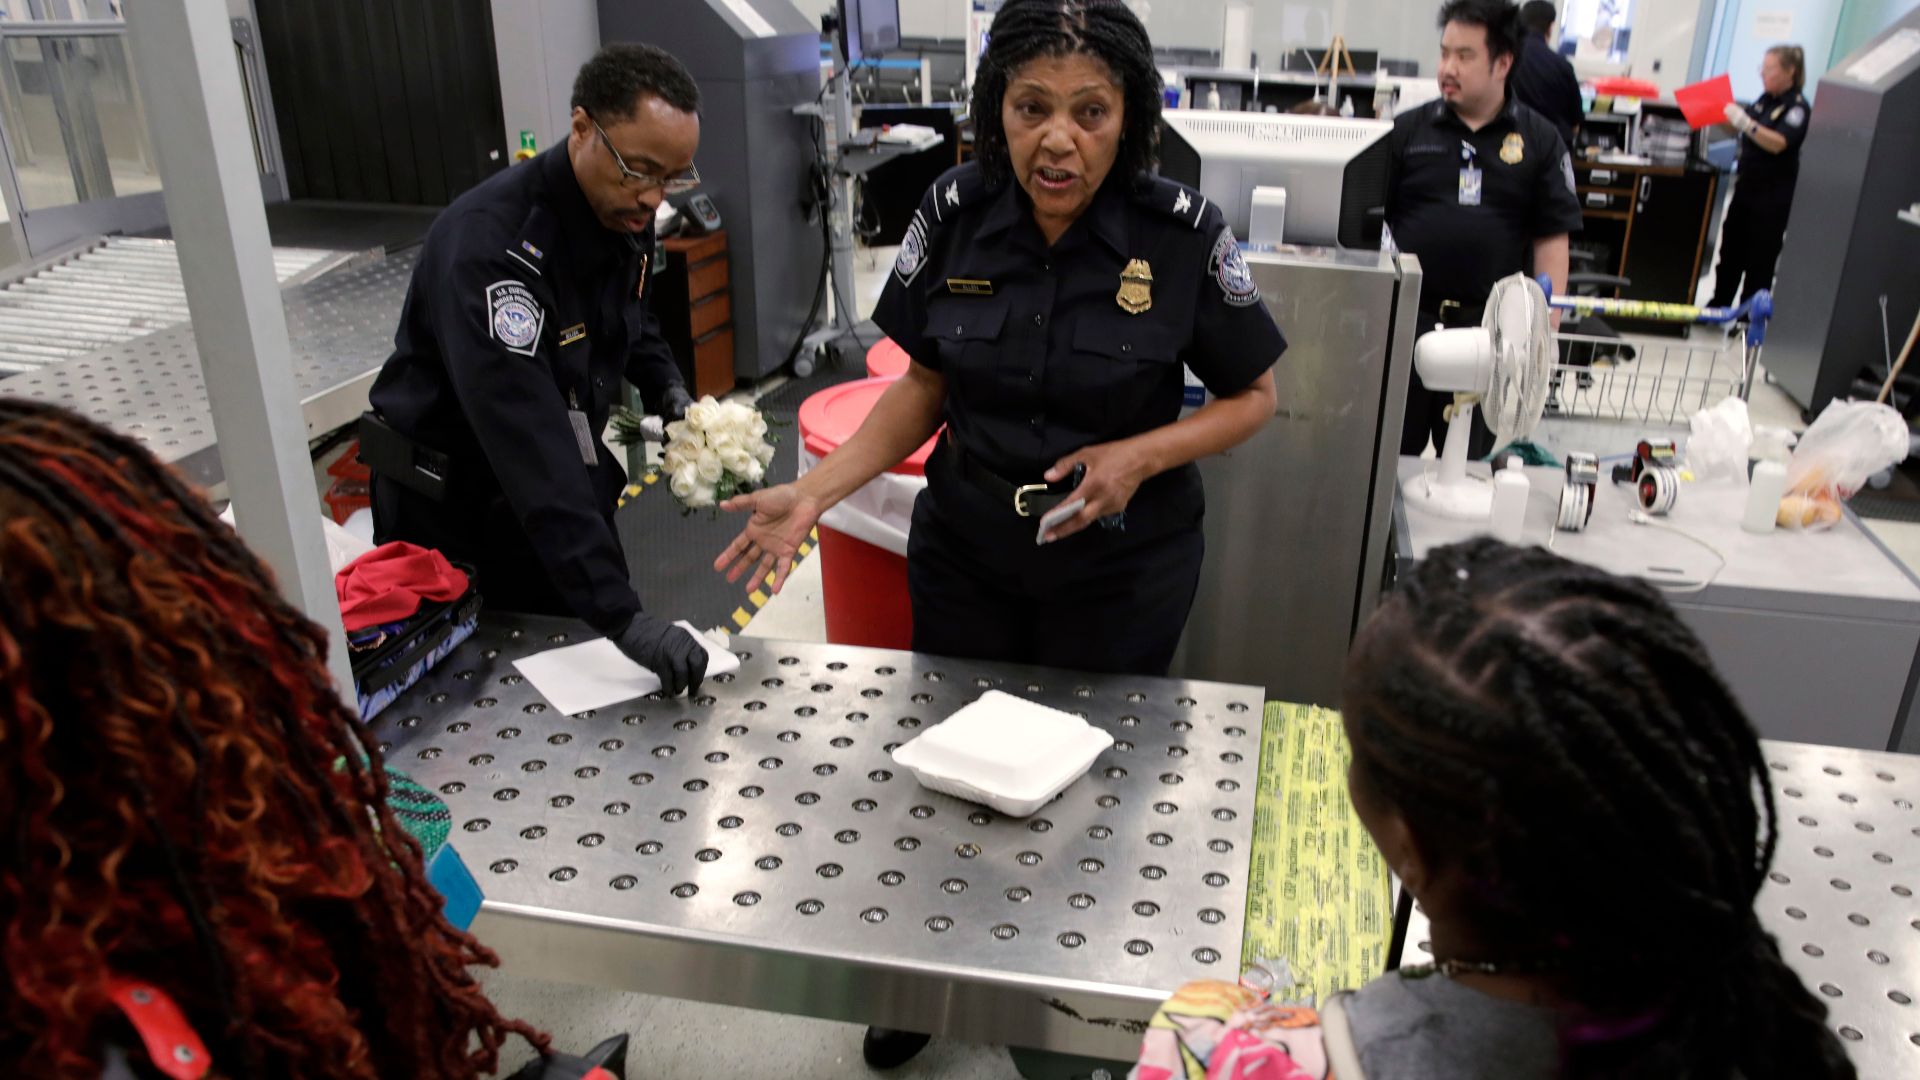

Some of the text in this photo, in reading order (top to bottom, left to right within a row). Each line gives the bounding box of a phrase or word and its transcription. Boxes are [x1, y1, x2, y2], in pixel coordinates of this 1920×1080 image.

[493, 294, 514, 309] BORDER
[1288, 837, 1298, 878] Agriculture
[1254, 853, 1266, 897] Agriculture
[1283, 881, 1296, 901] CBP
[1249, 900, 1262, 919] CBP
